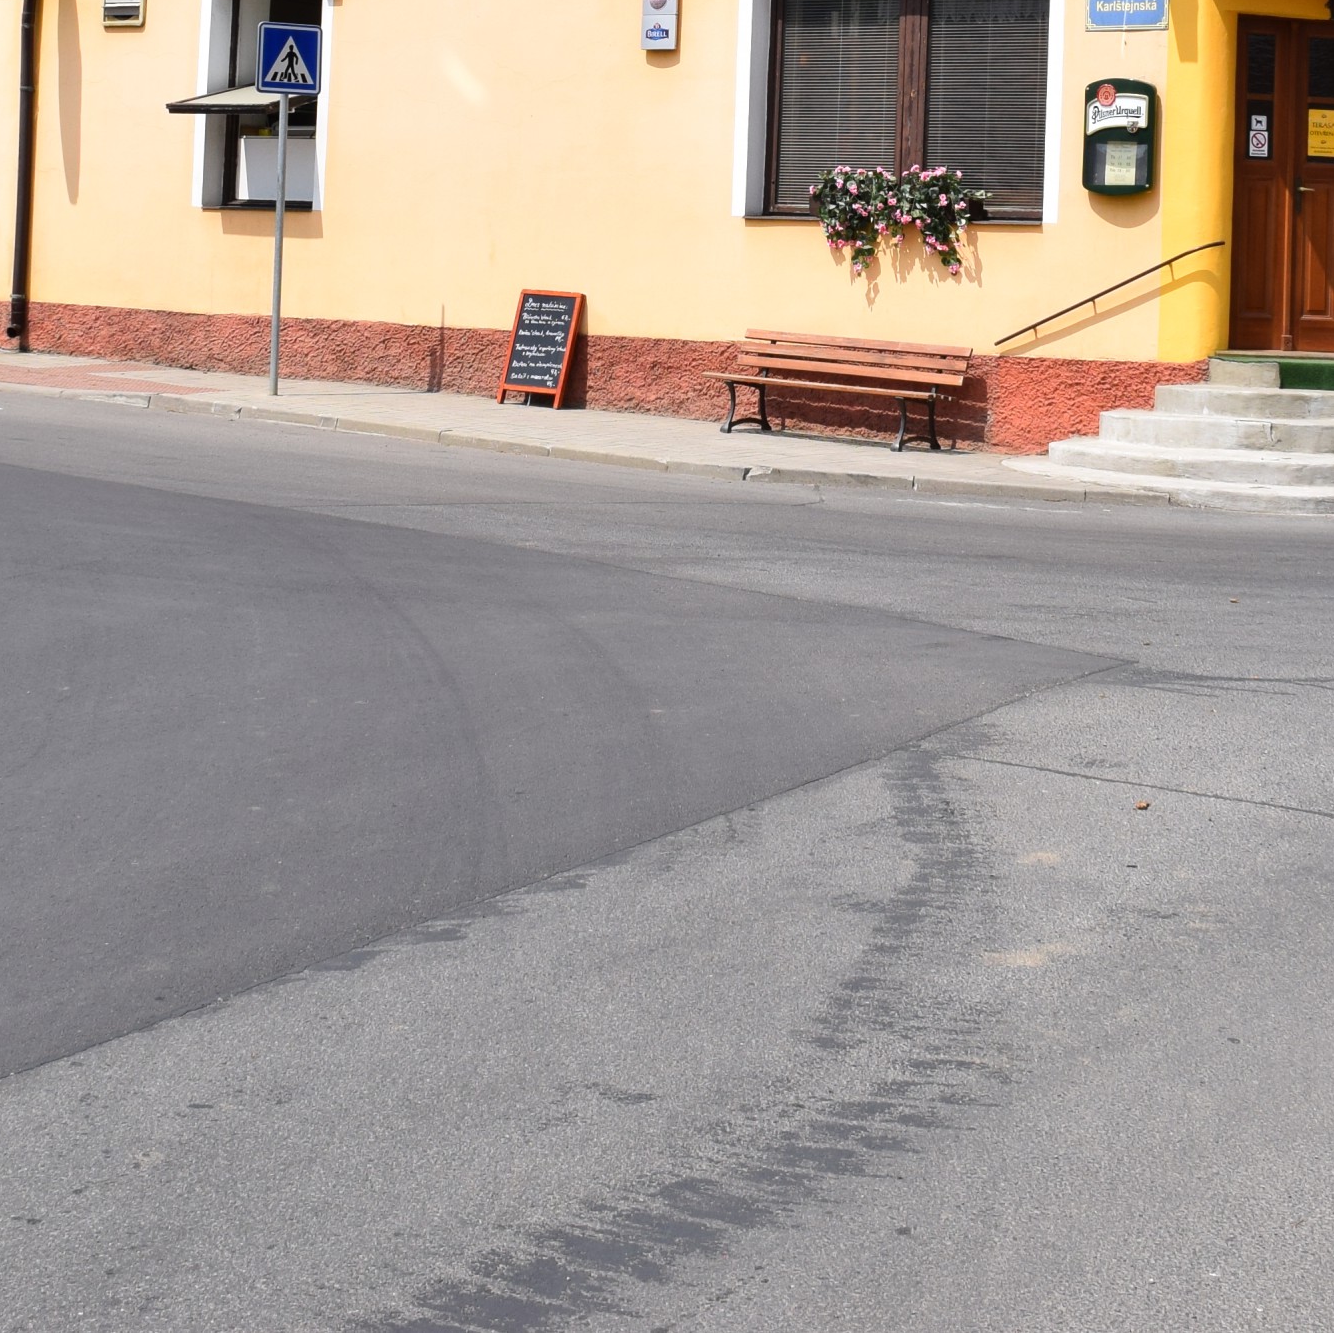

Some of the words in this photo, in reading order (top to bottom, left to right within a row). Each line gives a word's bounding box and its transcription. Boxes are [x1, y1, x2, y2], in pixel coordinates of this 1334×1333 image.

[1096, 0, 1158, 14] Karlštejnská
[1092, 105, 1116, 124] Pilsner
[1115, 105, 1142, 119] Urquell
